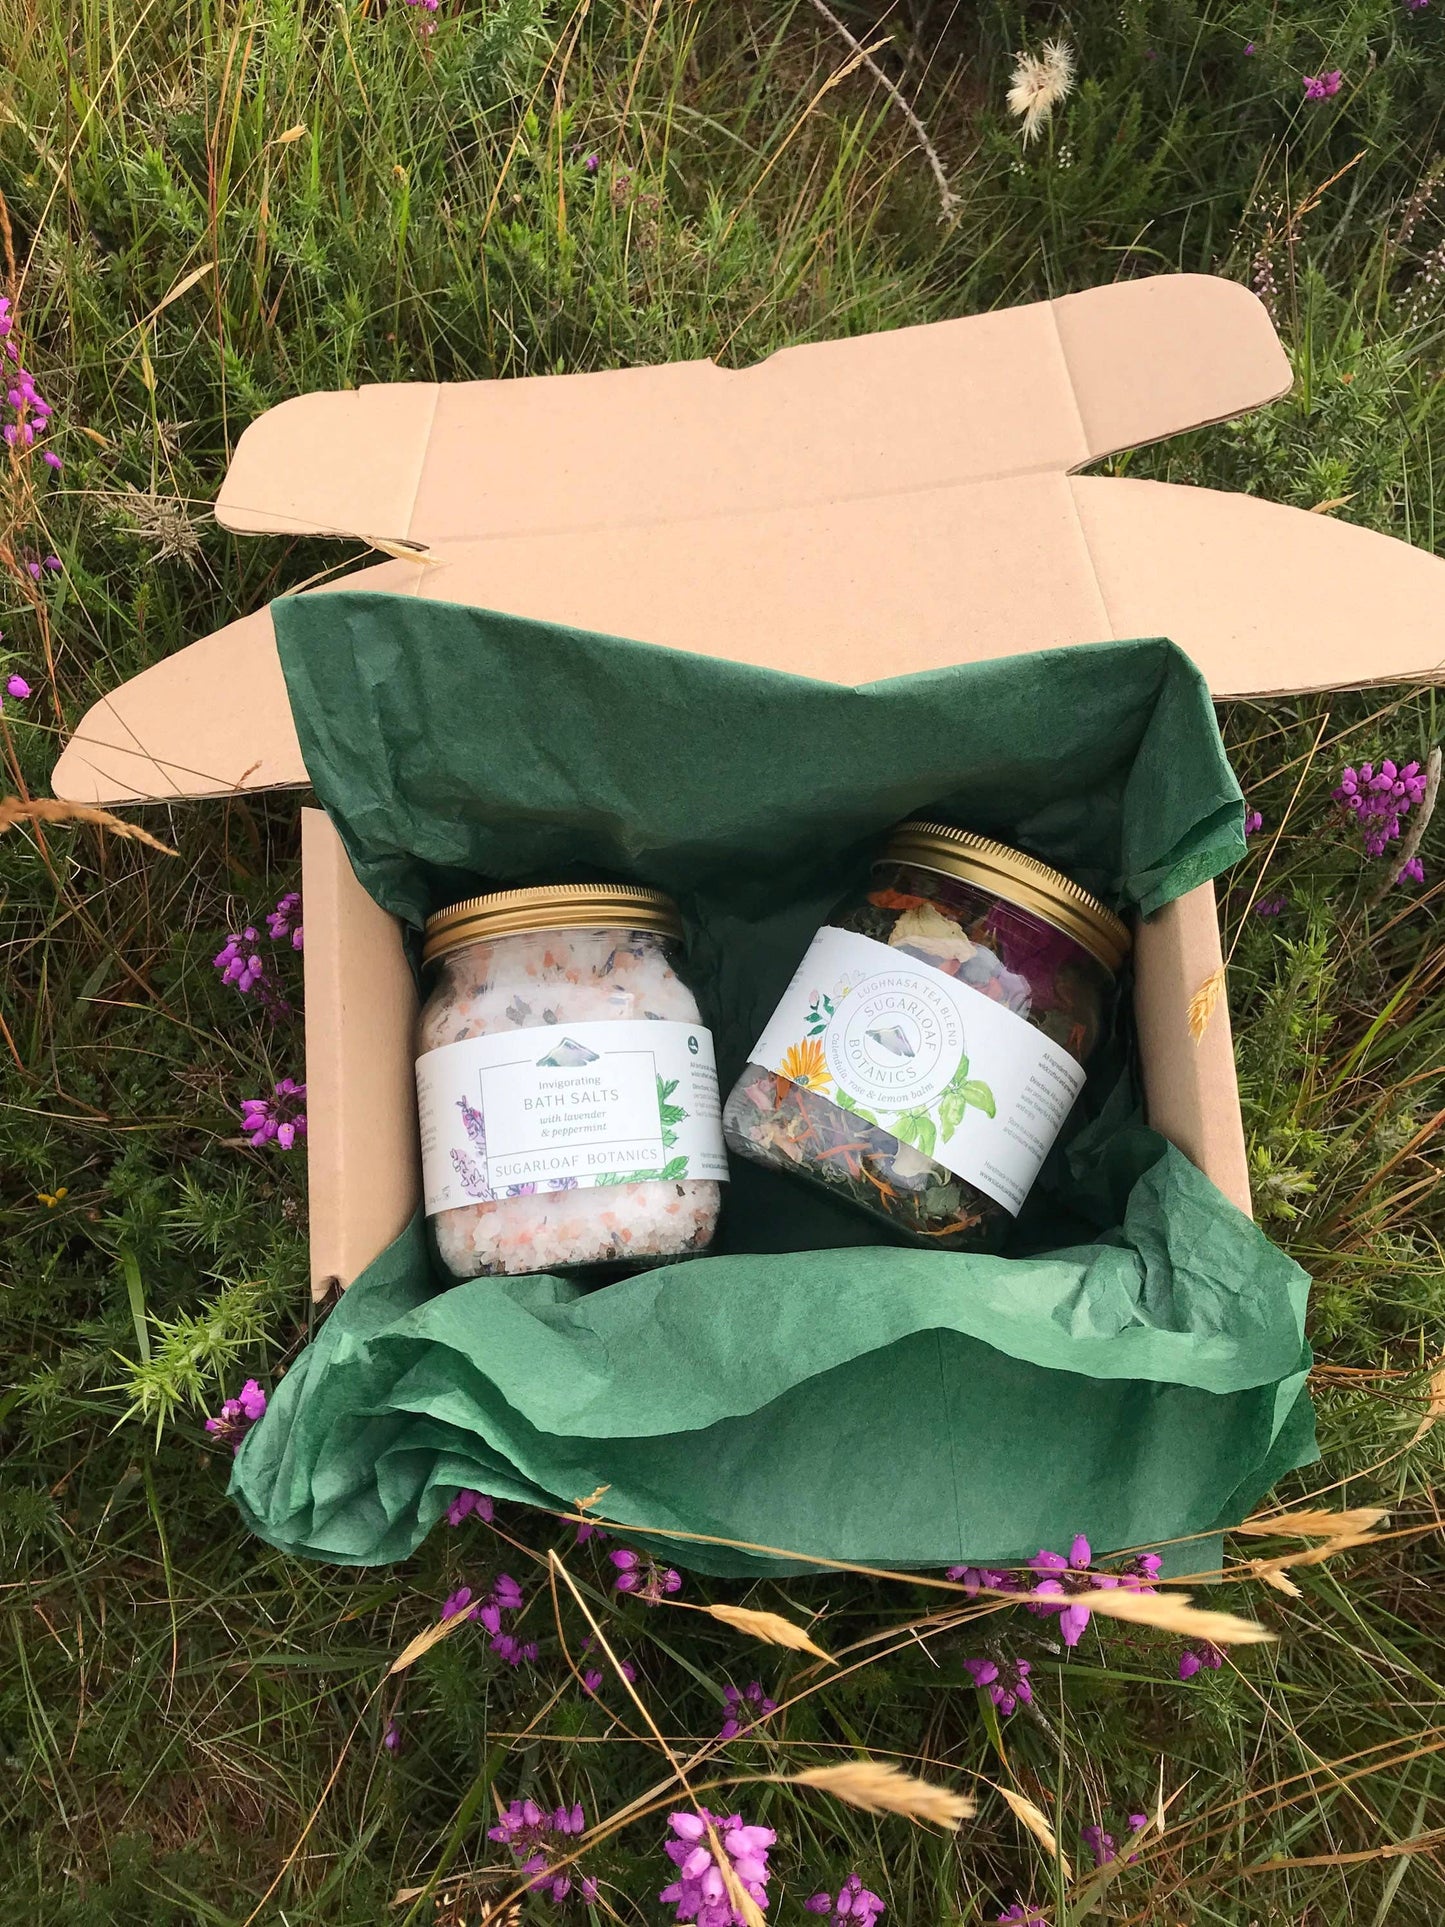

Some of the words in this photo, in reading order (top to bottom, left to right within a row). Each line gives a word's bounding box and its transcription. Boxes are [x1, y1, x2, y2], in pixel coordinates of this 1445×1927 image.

[858, 978, 918, 999] LUGHNASA
[923, 987, 941, 1006] TEA
[940, 1007, 957, 1047] BLEND
[864, 998, 937, 1051] SUGARLOAF
[849, 1039, 917, 1083] BOTANICS
[539, 1077, 601, 1090] Invigorating
[848, 1081, 865, 1094] rose
[866, 1090, 876, 1099] &
[877, 1093, 909, 1103] lemon
[911, 1082, 935, 1100] balm
[524, 1094, 565, 1110] BATH
[571, 1089, 619, 1105] SALTS
[540, 1114, 562, 1124] with
[564, 1110, 607, 1122] lavender
[541, 1128, 551, 1137] &
[552, 1123, 607, 1138] peppermint
[496, 1155, 580, 1177] SUGARLOAF
[587, 1149, 657, 1165] BOTANICS
